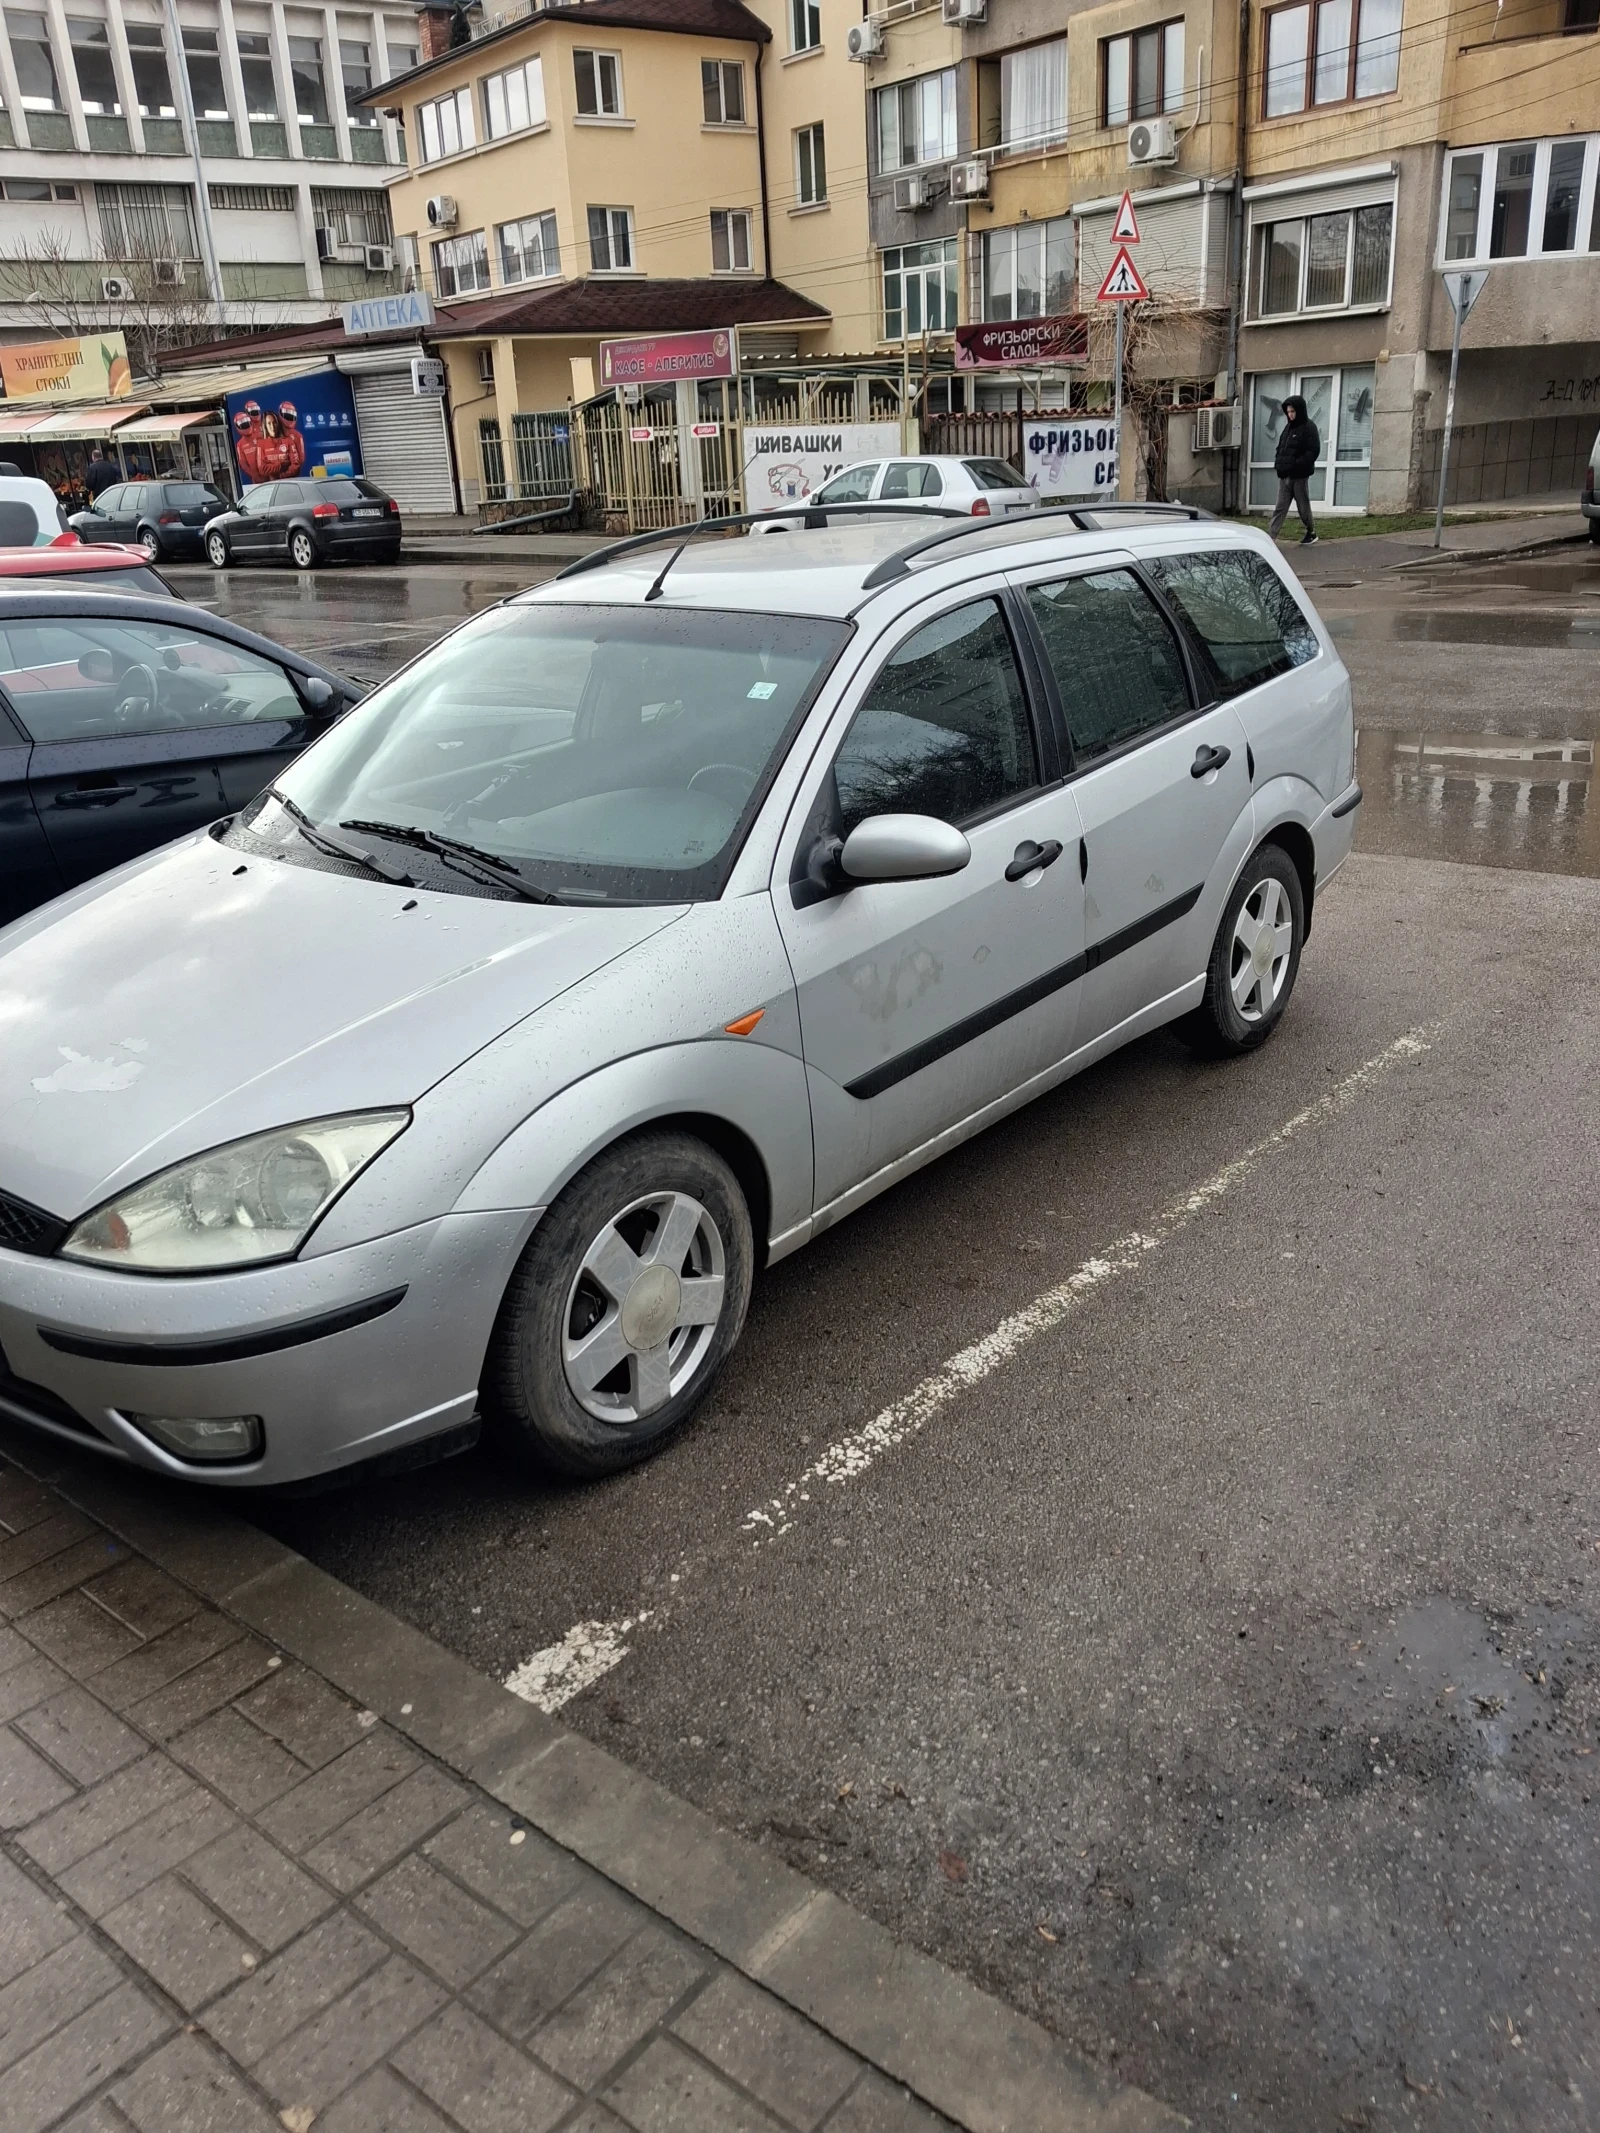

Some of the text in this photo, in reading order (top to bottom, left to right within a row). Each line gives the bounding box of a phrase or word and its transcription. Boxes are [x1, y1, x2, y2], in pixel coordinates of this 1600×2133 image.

[350, 297, 424, 331] АПТЕКА
[983, 325, 1060, 346] ФРИЗЬОРСКИ
[15, 351, 85, 372] ХРАНИТЕЛНИ
[1001, 343, 1041, 359] САЛОН
[615, 352, 715, 375] КАФЕ АПЕРИТИВ
[36, 376, 71, 392] СТОКИ
[756, 435, 842, 453] ШИВАШКИ
